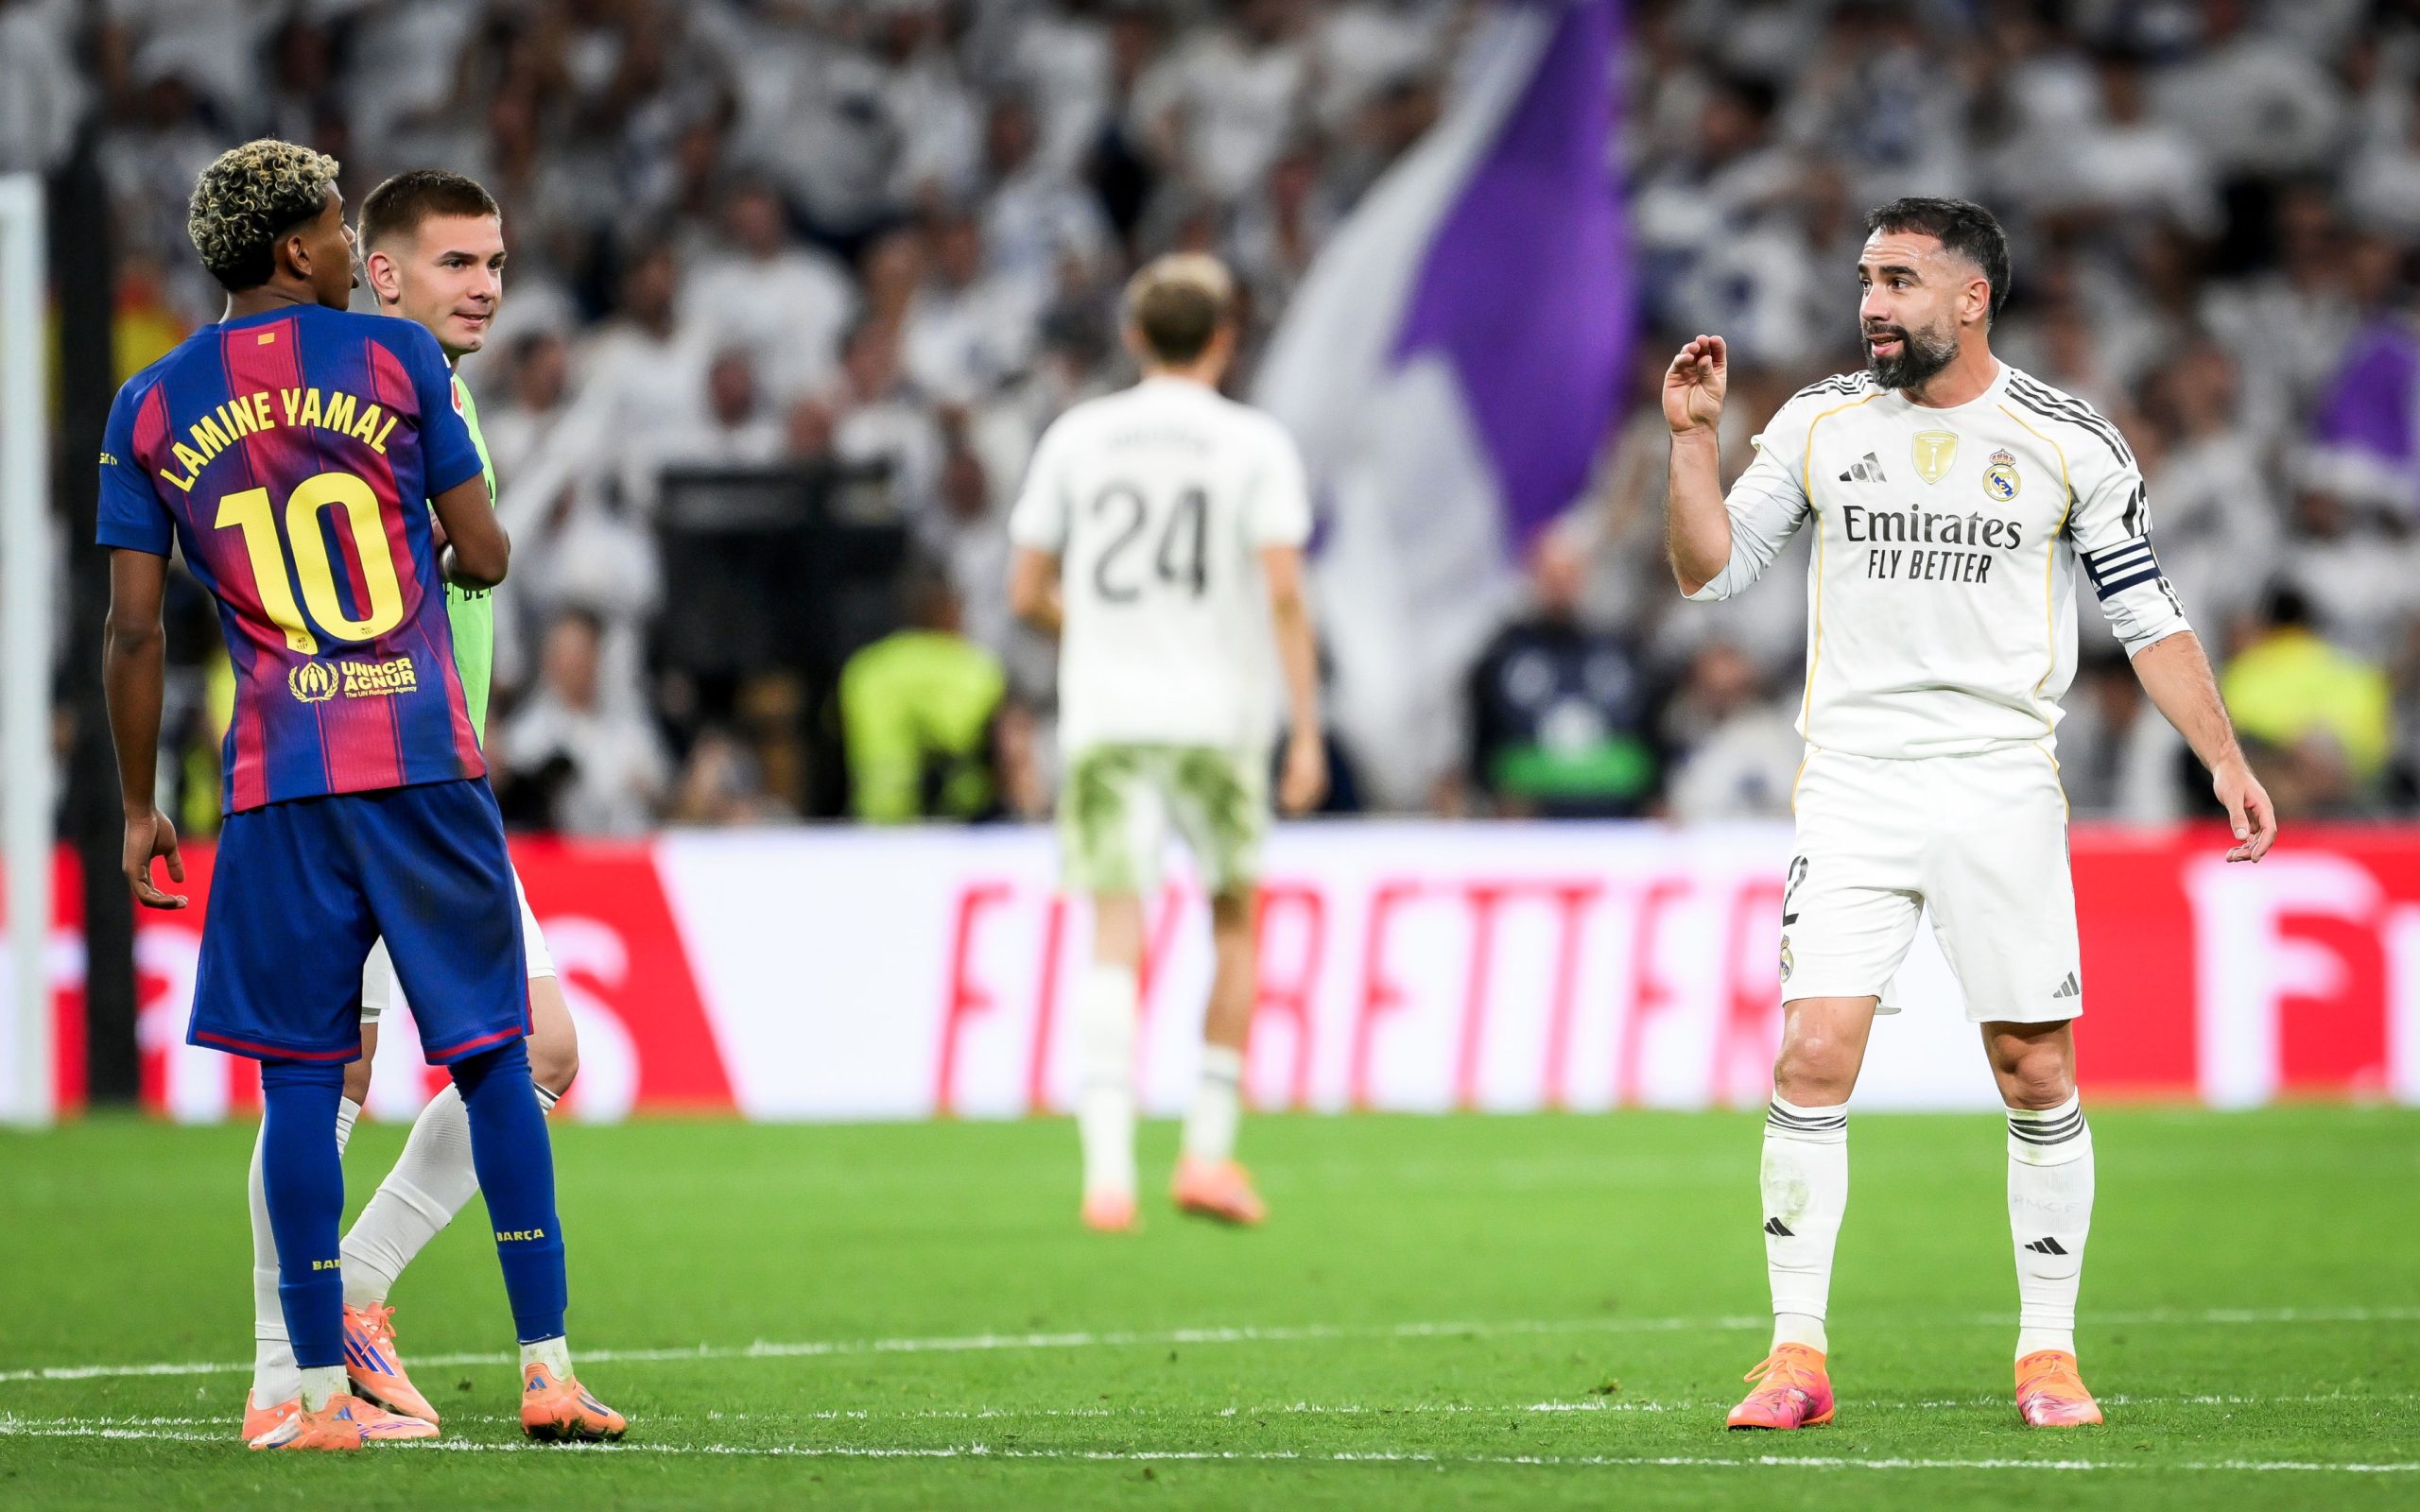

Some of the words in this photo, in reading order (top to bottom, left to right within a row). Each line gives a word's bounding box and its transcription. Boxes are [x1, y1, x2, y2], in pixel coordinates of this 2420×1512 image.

[160, 392, 276, 493] LAMINE
[281, 387, 398, 455] YAMAL
[1092, 479, 1208, 603] 24
[1842, 503, 2022, 550] Emirates
[214, 472, 405, 656] 10
[1867, 548, 1901, 579] FLY
[1909, 549, 1993, 584] BETTER
[340, 658, 412, 677] UNHCR
[344, 670, 416, 691] ACNUR
[1783, 854, 1809, 927] 2
[496, 1228, 544, 1242] BARÇA
